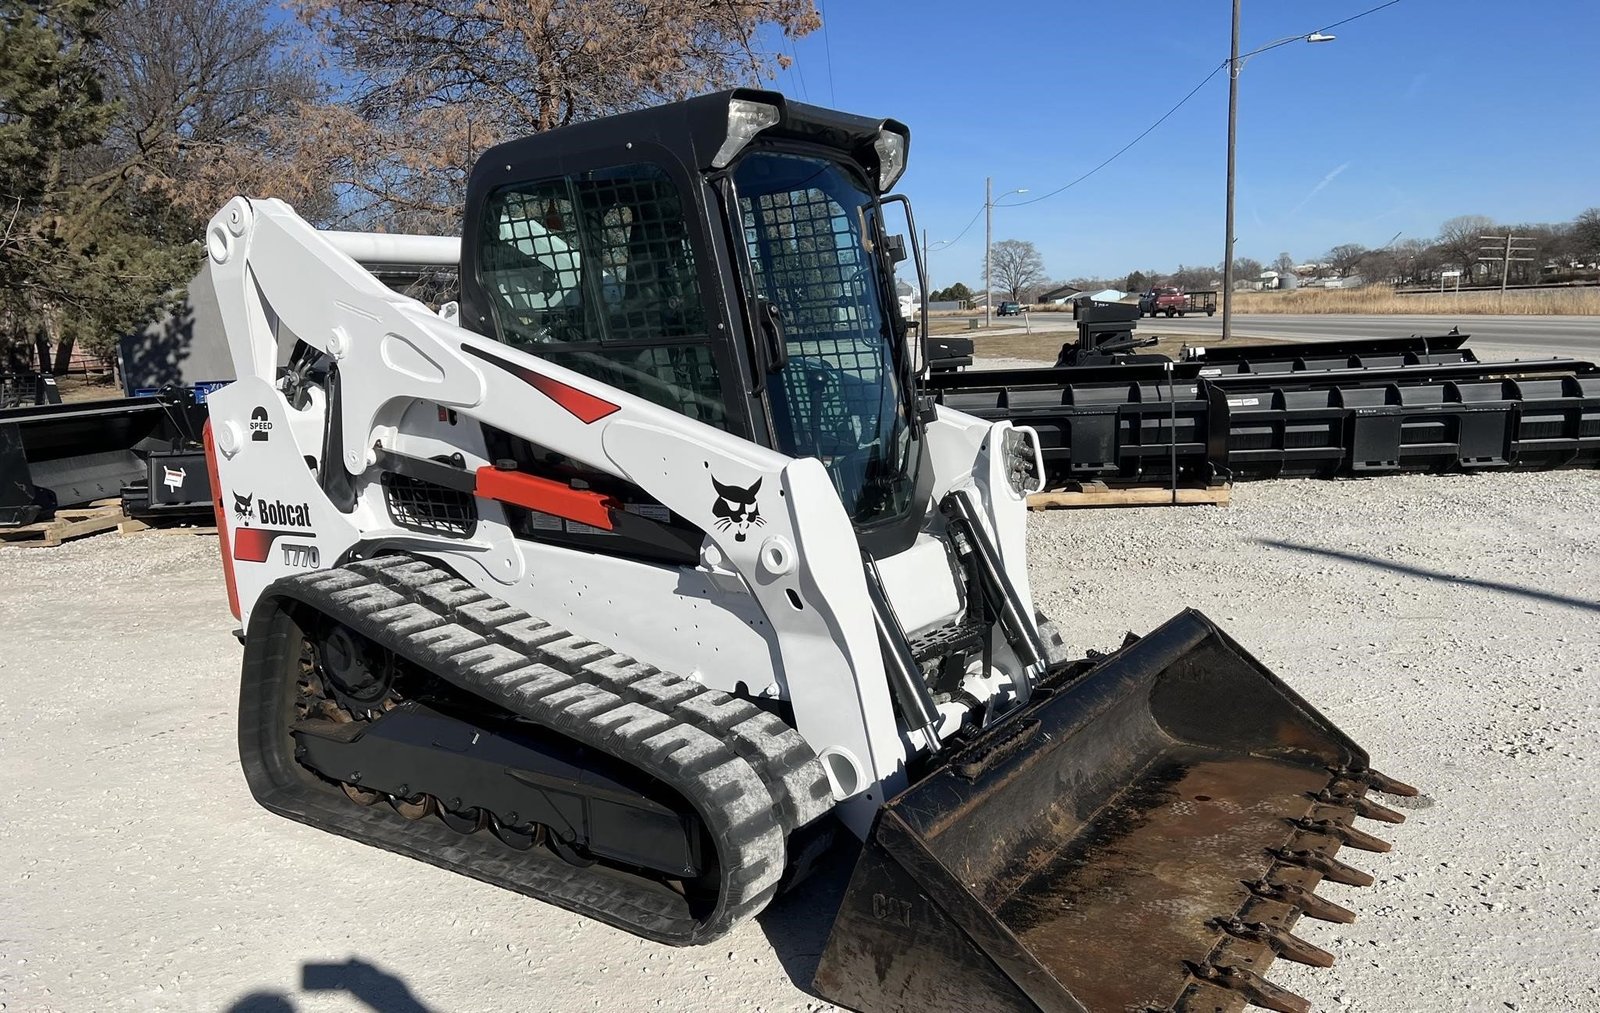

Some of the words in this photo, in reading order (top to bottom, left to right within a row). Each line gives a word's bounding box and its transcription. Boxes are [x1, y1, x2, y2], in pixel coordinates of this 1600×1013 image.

[249, 422, 273, 430] SPEED
[251, 406, 269, 441] 2
[257, 499, 312, 527] Bobcat
[281, 543, 320, 569] T770
